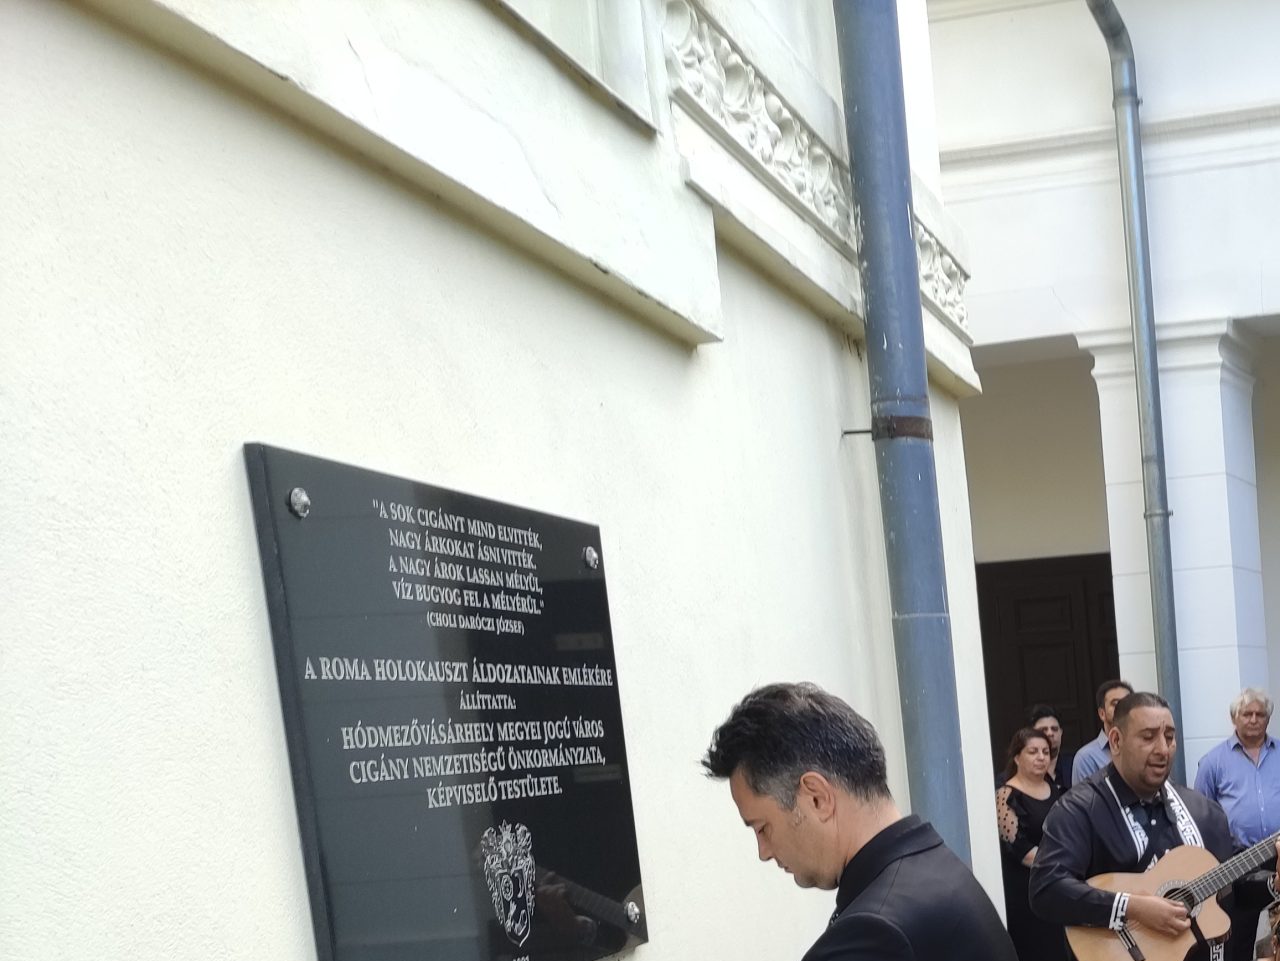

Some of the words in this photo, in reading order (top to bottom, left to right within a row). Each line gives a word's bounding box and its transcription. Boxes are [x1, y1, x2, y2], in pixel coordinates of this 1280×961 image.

[389, 502, 416, 524] SOK
[417, 507, 466, 534] CIGÁNYT
[467, 518, 496, 539] MIND
[498, 525, 543, 551] ELVITTÉK,
[389, 528, 421, 550] NAGY
[424, 530, 475, 559] ÁRKOKAT
[477, 540, 500, 563] ÁSNI
[499, 548, 537, 570] VITTÉK.
[389, 555, 398, 573] A
[400, 556, 431, 577] NAGY
[434, 557, 465, 582] ÁROK
[466, 565, 503, 588] LASSAN
[392, 577, 414, 600] VÍZ
[415, 584, 461, 606] BUGYOG
[463, 590, 482, 608] FEL
[483, 593, 491, 608] A
[427, 611, 457, 628] (CHOLI
[459, 613, 495, 632] DARÓCZI
[496, 615, 525, 636] JÓZSEF)
[304, 657, 317, 680] A
[319, 657, 372, 681] ROMA
[373, 659, 469, 683] HOLOKAUSZT
[472, 657, 561, 685] ÁLDOZATAINAK
[562, 662, 613, 686] EMLÉKÉRE
[460, 689, 516, 710] ÁLLÍTTATTA:
[341, 718, 494, 749] HÓDMEZŐVÁSÁRHELY
[497, 721, 541, 741] MEGYEI
[543, 715, 571, 745] JOGÚ
[573, 715, 604, 738] VÁROS
[350, 753, 409, 784] CIGÁNY
[412, 745, 505, 778] NEMZETISÉGŰ
[508, 743, 605, 770] ÖNKORMÁNYZATA,
[426, 776, 498, 809] KÉPVISELŐ
[499, 774, 562, 800] TESTÜLETE.
